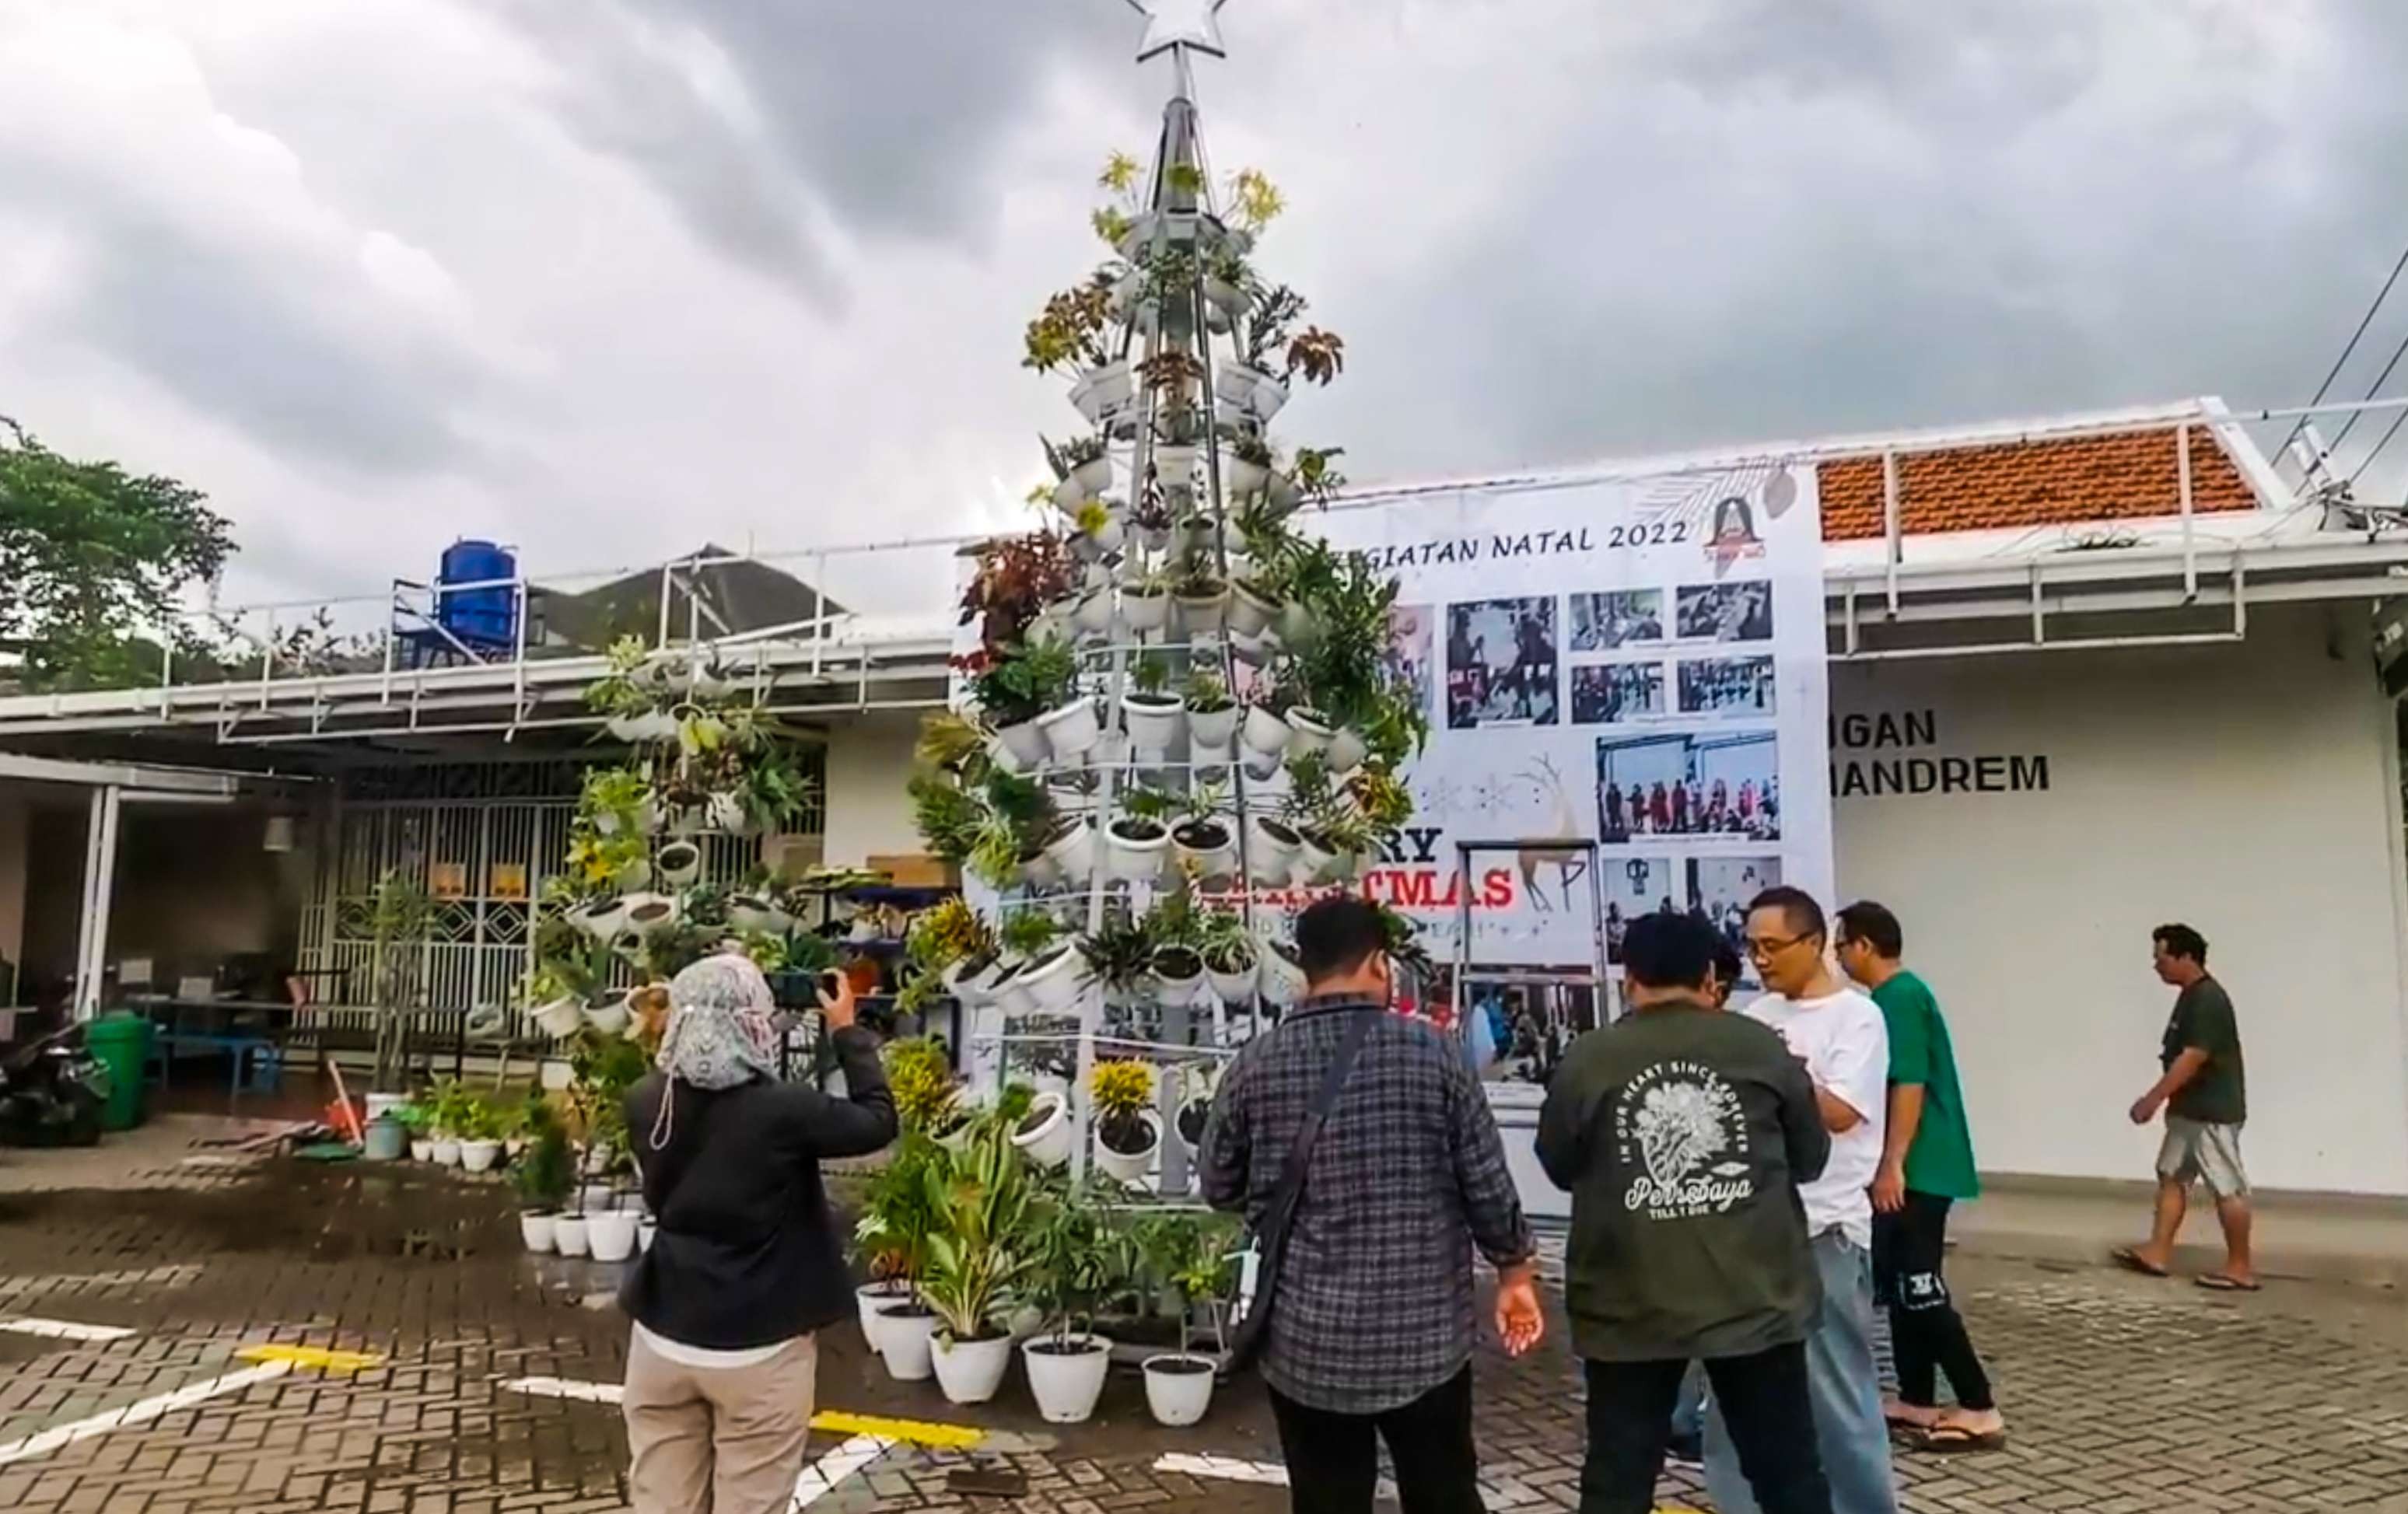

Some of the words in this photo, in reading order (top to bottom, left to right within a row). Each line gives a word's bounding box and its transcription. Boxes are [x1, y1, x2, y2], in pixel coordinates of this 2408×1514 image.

[1330, 538, 1479, 573] GIATAN
[1492, 526, 1594, 558] NATAL
[1608, 521, 1687, 547] 2022
[1829, 708, 1936, 750] GAN
[1830, 755, 2049, 798] ANDREM
[1622, 1063, 1663, 1101] HEART
[1670, 1061, 1717, 1086] SINCE
